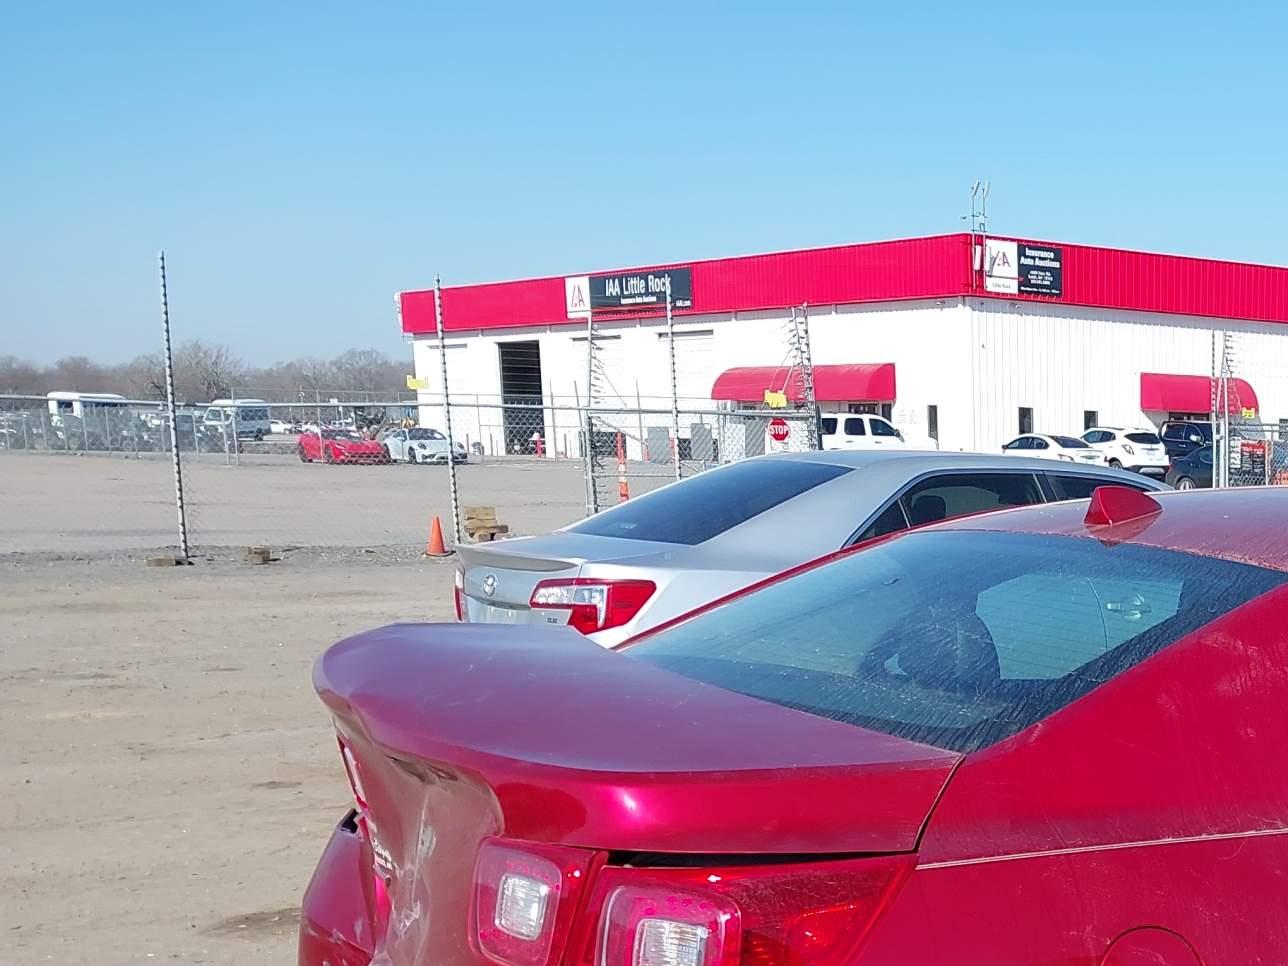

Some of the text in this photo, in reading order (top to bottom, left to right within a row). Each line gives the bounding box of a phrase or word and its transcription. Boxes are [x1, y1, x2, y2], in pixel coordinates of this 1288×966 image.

[606, 273, 671, 296] IAA Little Rock
[770, 424, 788, 435] STOP
